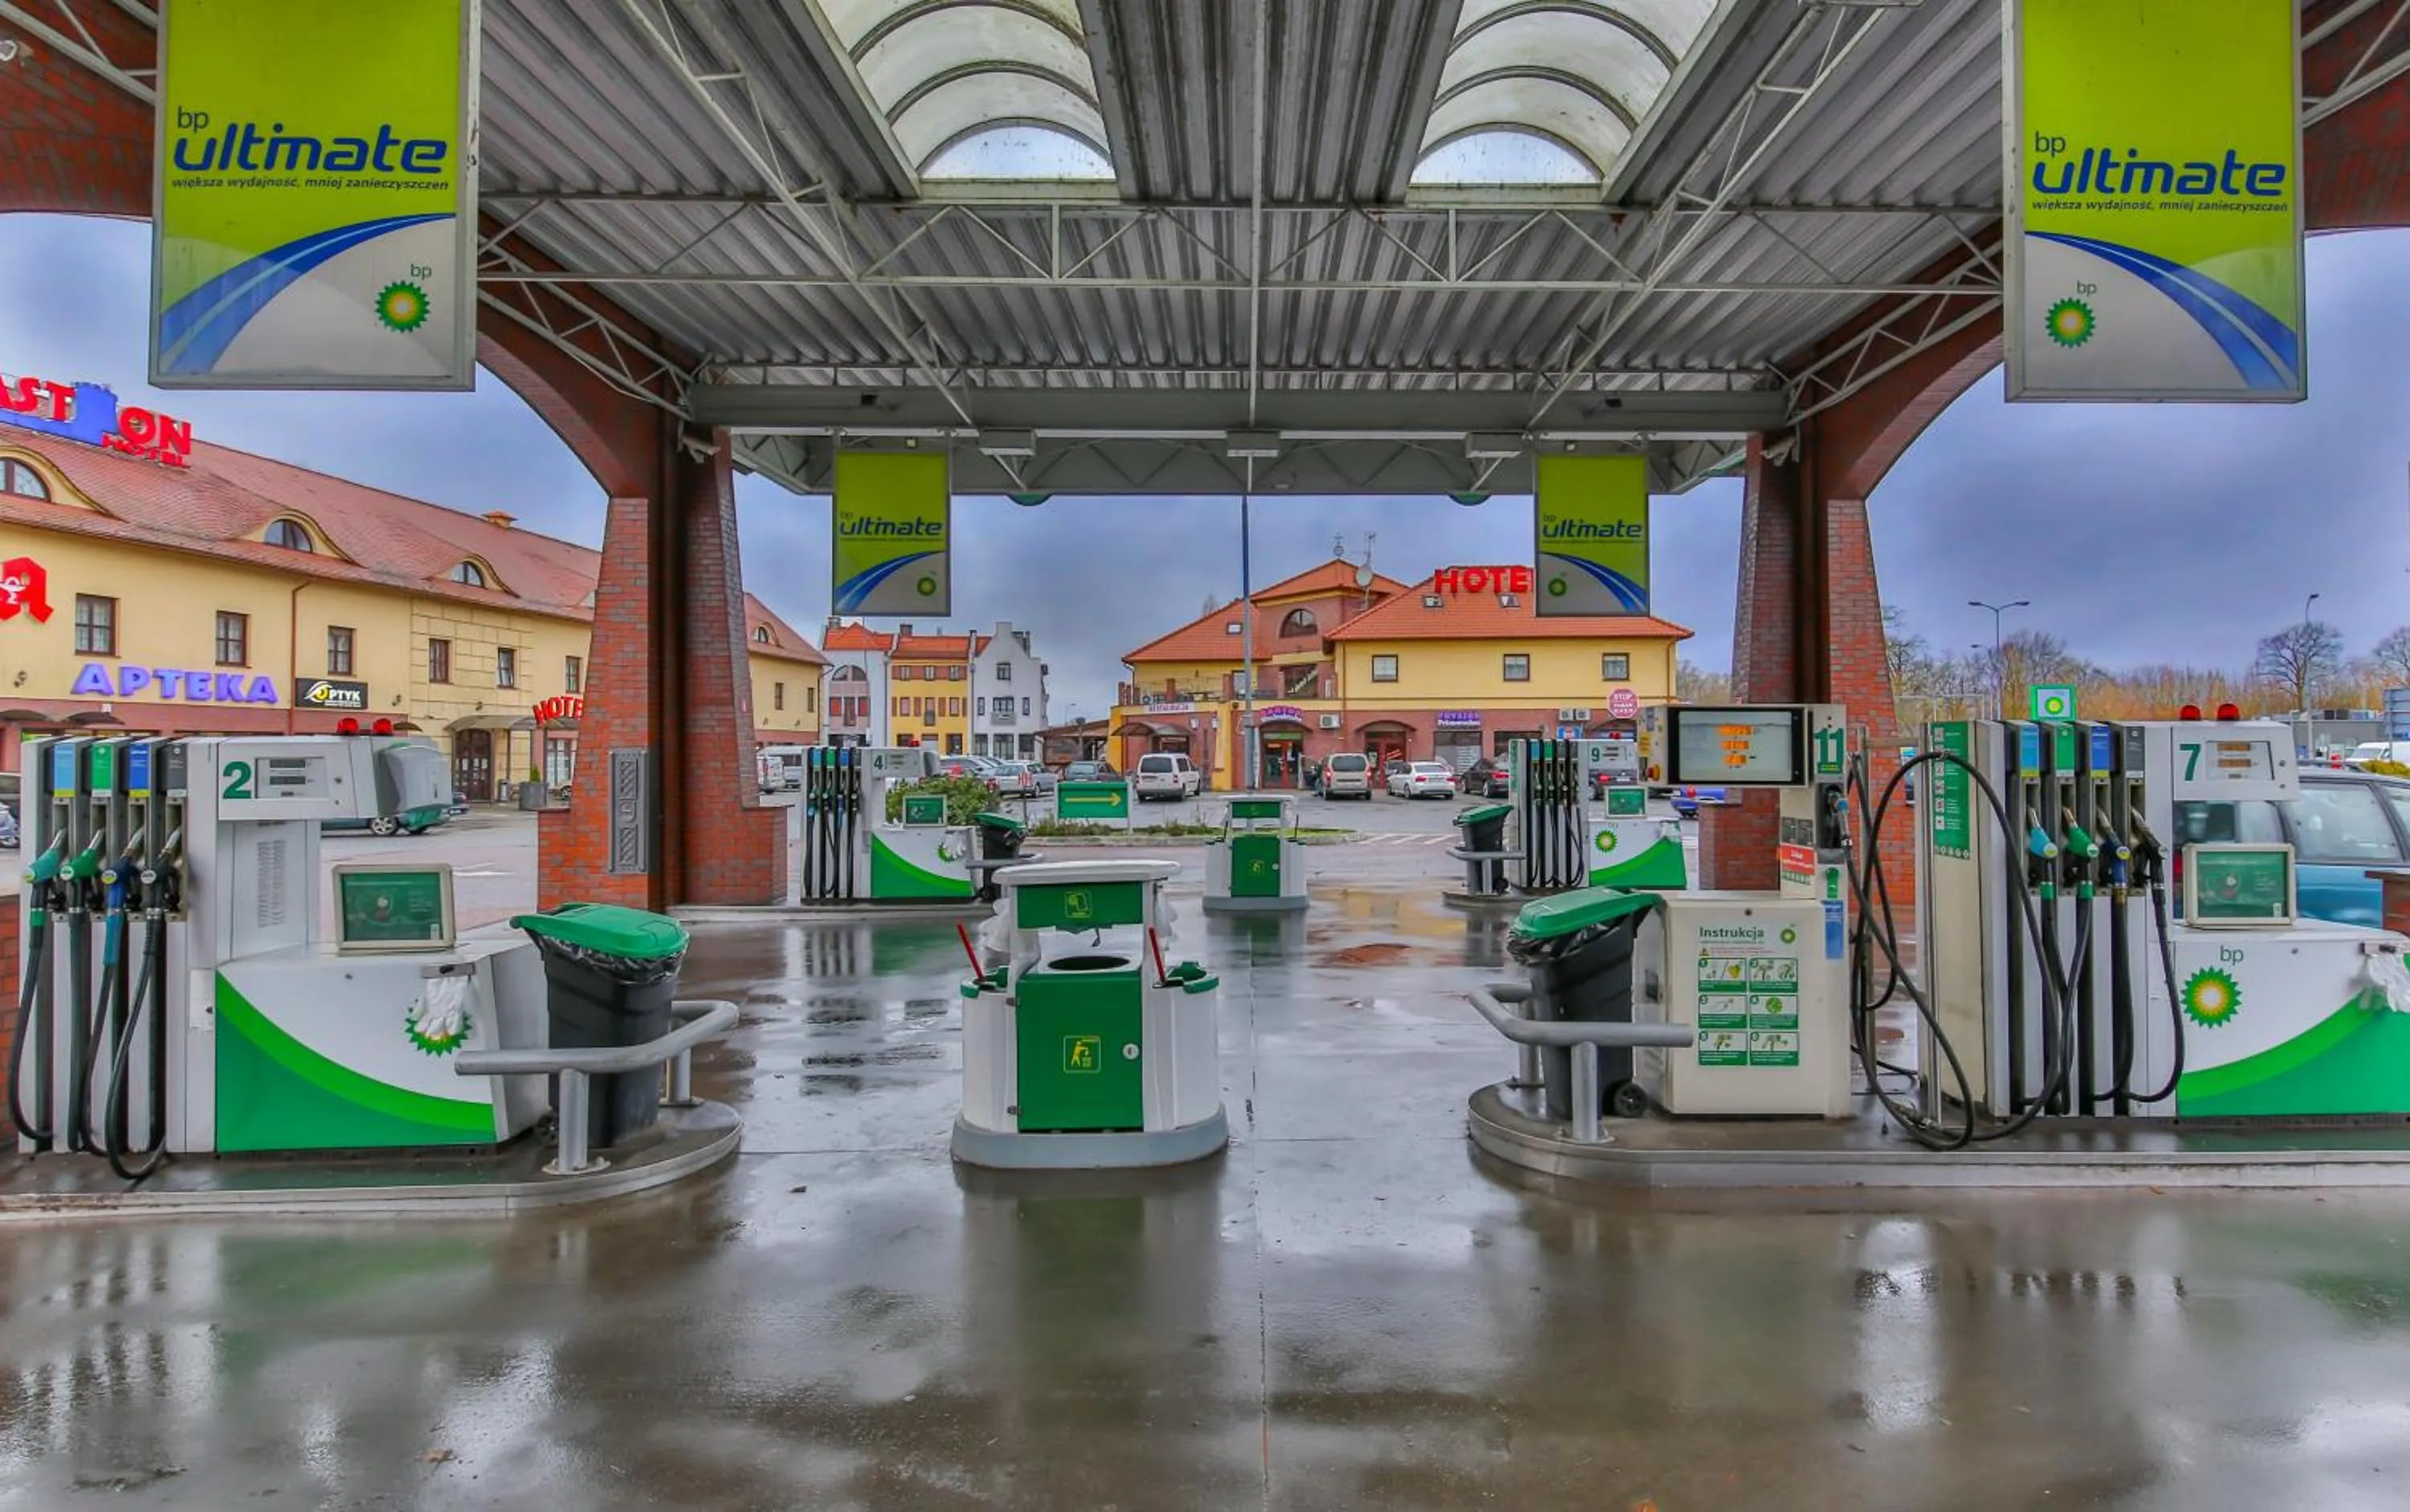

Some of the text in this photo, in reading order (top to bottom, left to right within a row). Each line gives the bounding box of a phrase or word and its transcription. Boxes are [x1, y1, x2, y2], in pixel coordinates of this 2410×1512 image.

[177, 106, 210, 133] bp
[173, 123, 447, 174] ultimate
[2034, 131, 2066, 157] bp
[2032, 148, 2286, 196] ultimate
[172, 178, 223, 189] większa
[304, 178, 343, 190] mniej
[2032, 199, 2082, 210] większa
[2159, 200, 2194, 213] mniej
[411, 263, 432, 280] bp
[2077, 280, 2098, 297] bp
[839, 516, 942, 536] ultimate
[1542, 518, 1644, 537] ultimate
[1435, 566, 1534, 593] HOTE
[71, 663, 279, 705] APTEKA
[1591, 747, 1600, 762] 9
[1813, 727, 1844, 764] 11
[873, 755, 884, 770] 4
[2179, 743, 2202, 782] 7
[222, 761, 252, 799] 2
[1699, 926, 1765, 940] Instrukcja
[2220, 945, 2245, 966] bp
